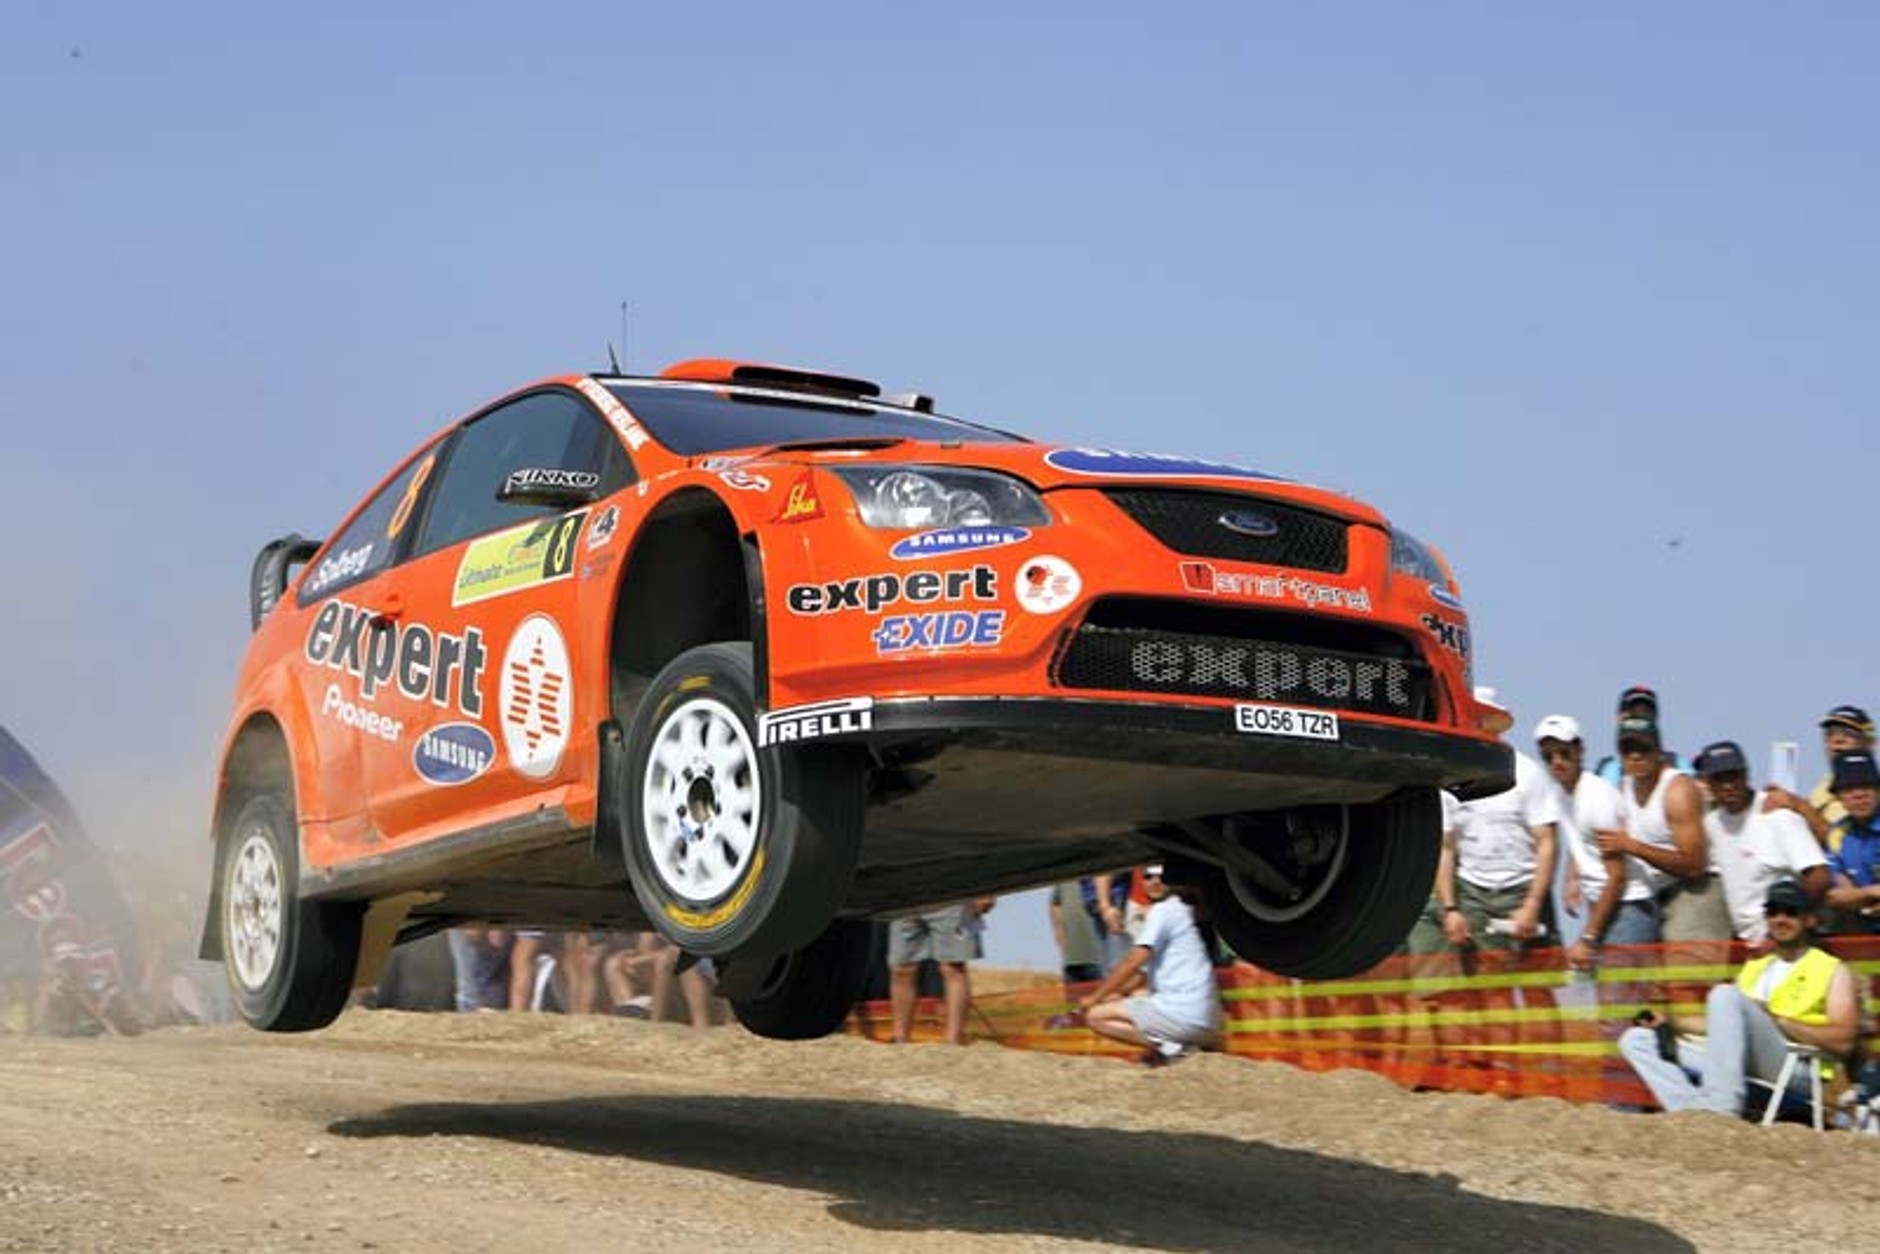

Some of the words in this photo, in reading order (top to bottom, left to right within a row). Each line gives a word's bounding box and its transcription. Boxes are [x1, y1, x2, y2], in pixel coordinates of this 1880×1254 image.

[554, 517, 576, 564] 8
[910, 532, 1016, 547] SAMSUNG
[786, 564, 998, 613] expert
[873, 612, 1004, 652] EXIDE
[306, 598, 488, 720] expert
[1132, 641, 1409, 706] expert
[322, 682, 405, 742] Pioneer
[758, 695, 873, 749] PIRELLI
[1297, 711, 1335, 736] TZR
[423, 732, 487, 774] SAMSUNG
